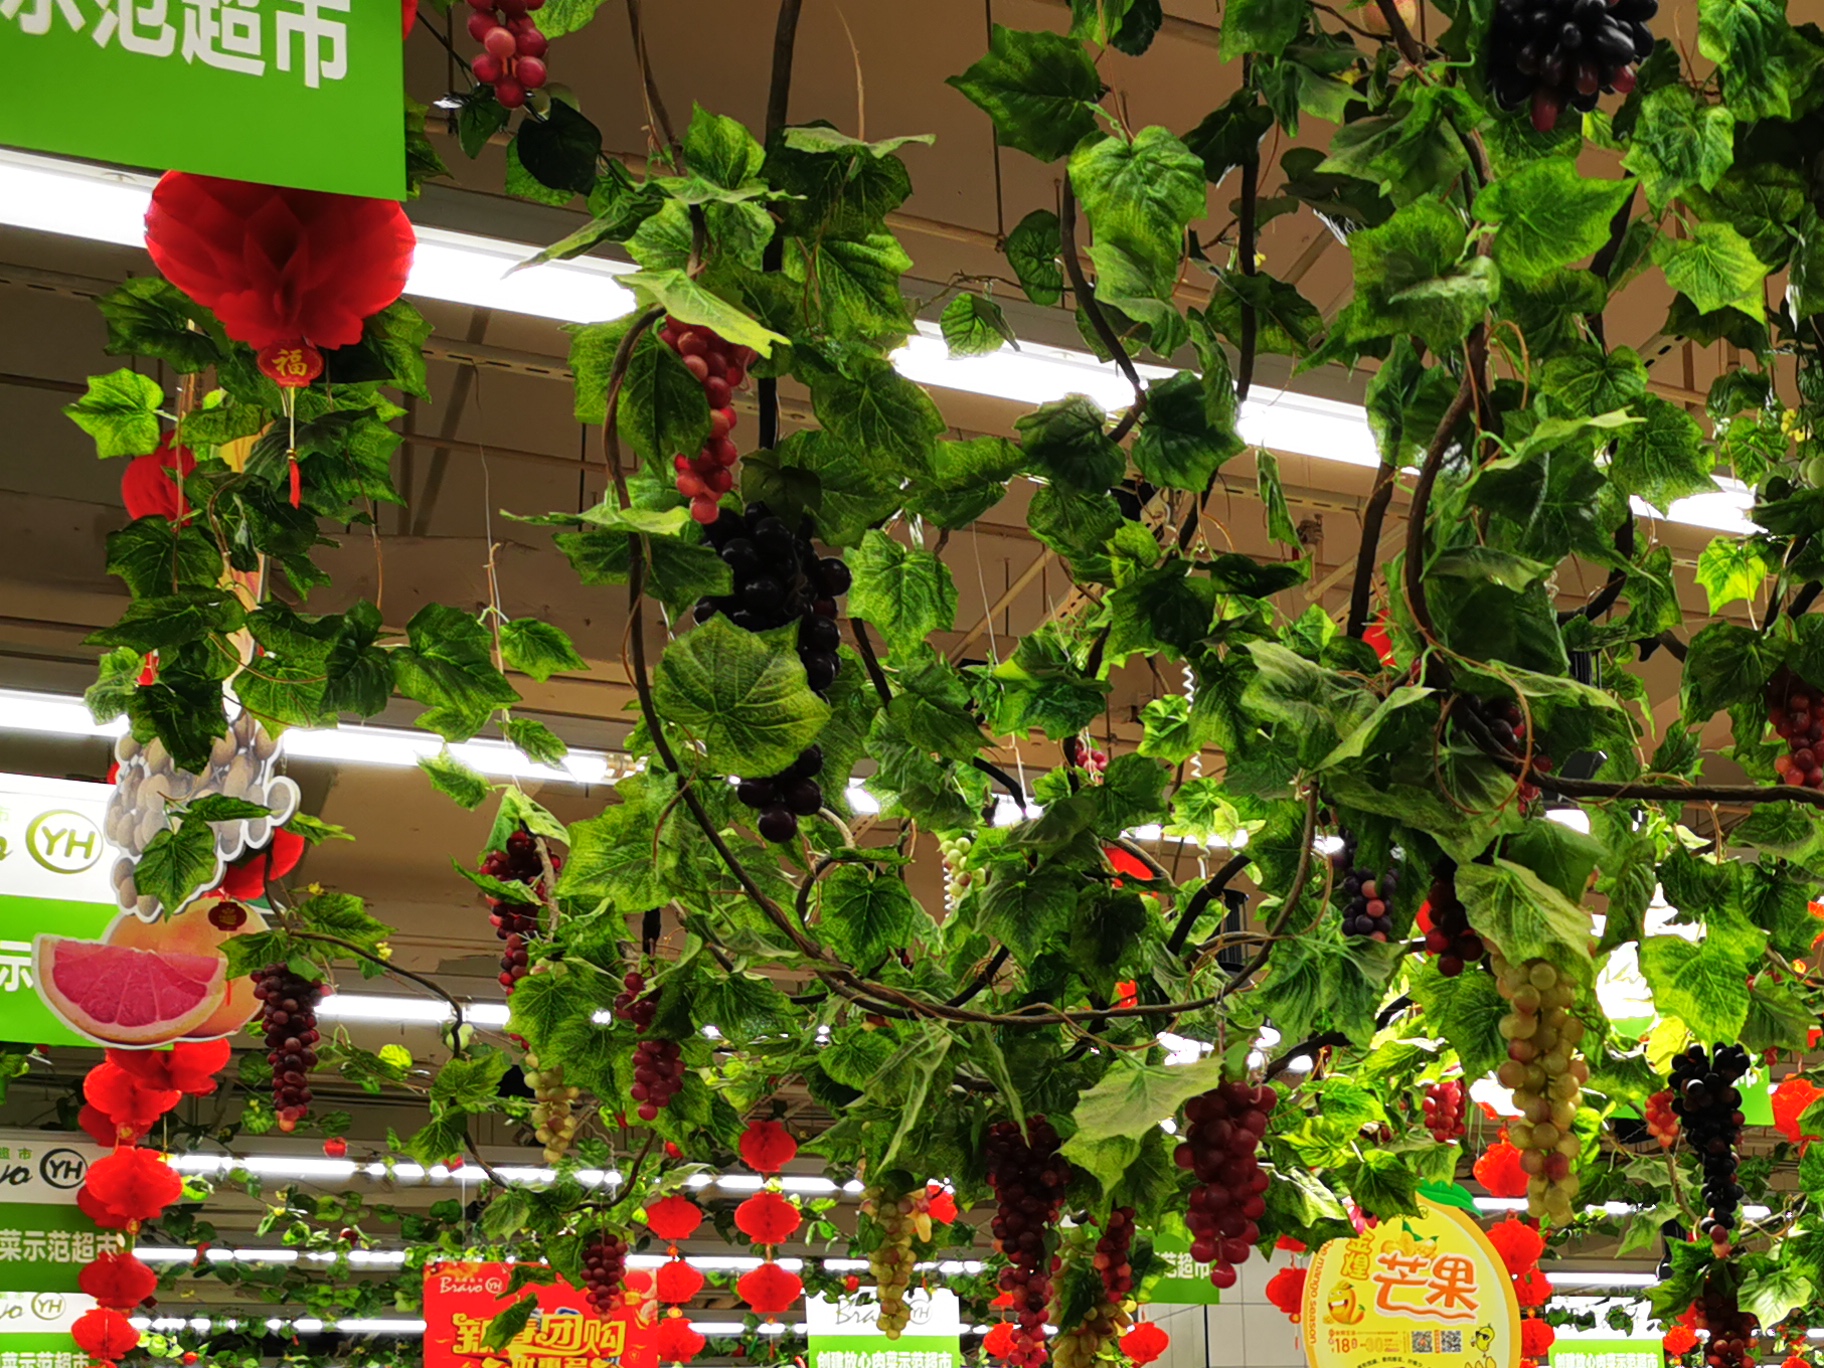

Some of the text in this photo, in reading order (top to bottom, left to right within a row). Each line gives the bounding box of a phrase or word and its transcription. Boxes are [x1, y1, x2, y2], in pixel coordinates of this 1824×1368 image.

[440, 1276, 483, 1294] Bravo
[1307, 1256, 1325, 1344] mango season
[1373, 1254, 1479, 1318] 芒果
